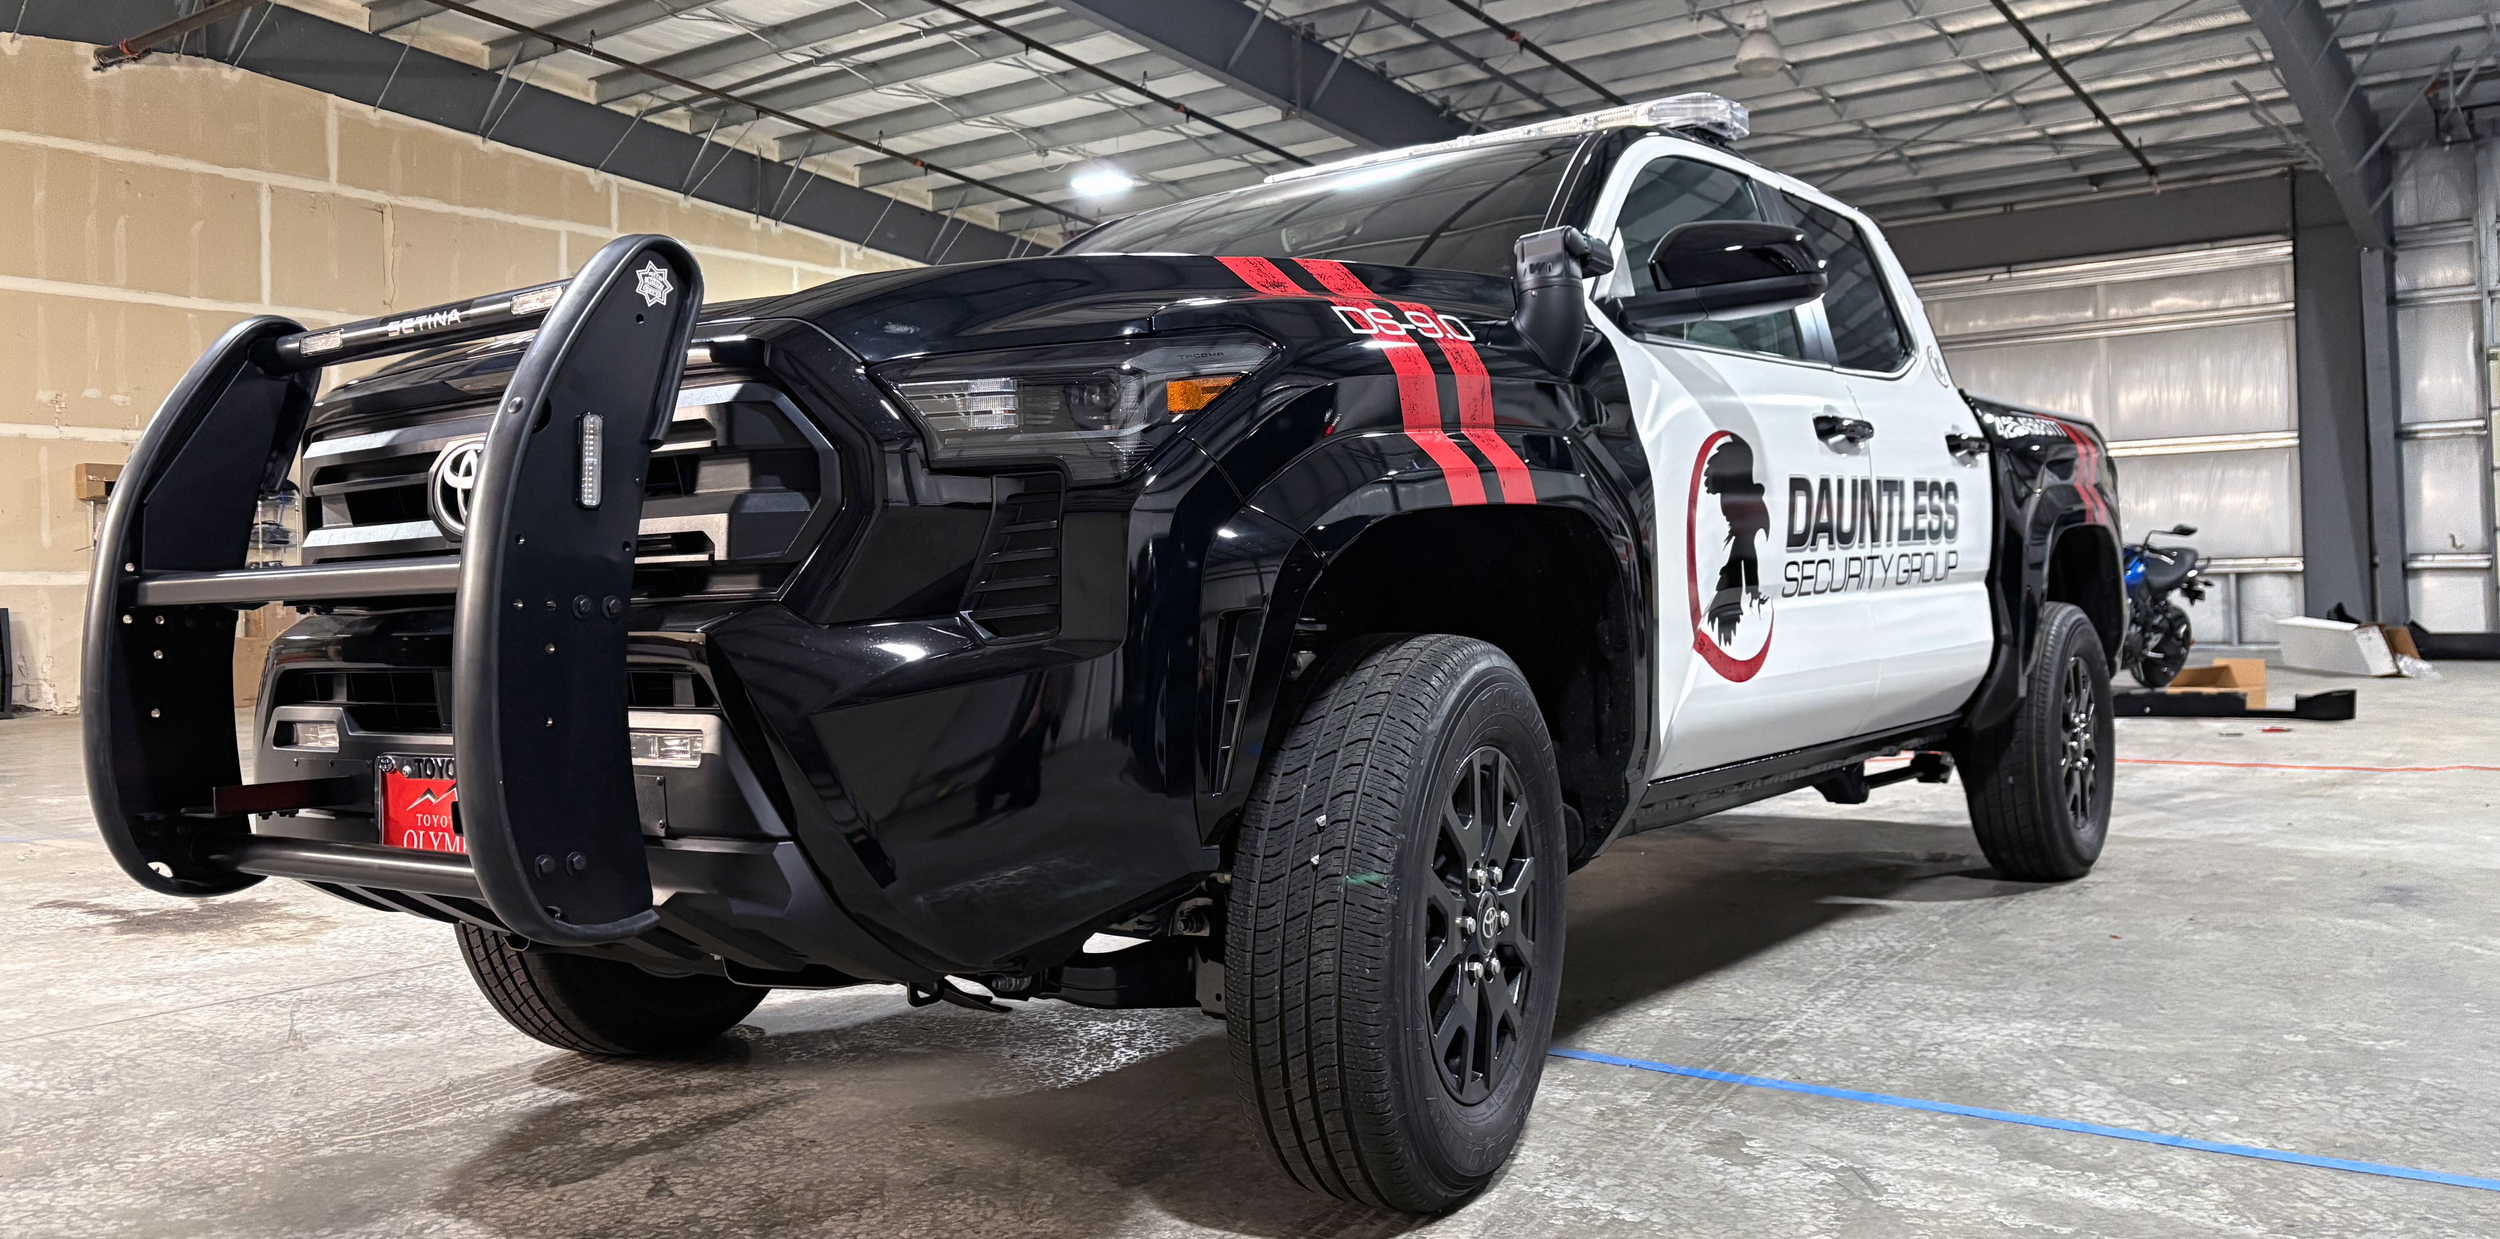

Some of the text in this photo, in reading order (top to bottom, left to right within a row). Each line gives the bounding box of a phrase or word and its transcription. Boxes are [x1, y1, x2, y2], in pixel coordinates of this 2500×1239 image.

[387, 308, 462, 337] SETINA
[1330, 305, 1476, 342] DS-9.0
[1177, 351, 1225, 360] TACOMA
[1785, 473, 1960, 553] DAUNTLESS
[1781, 551, 1958, 599] SECURITY GROUP
